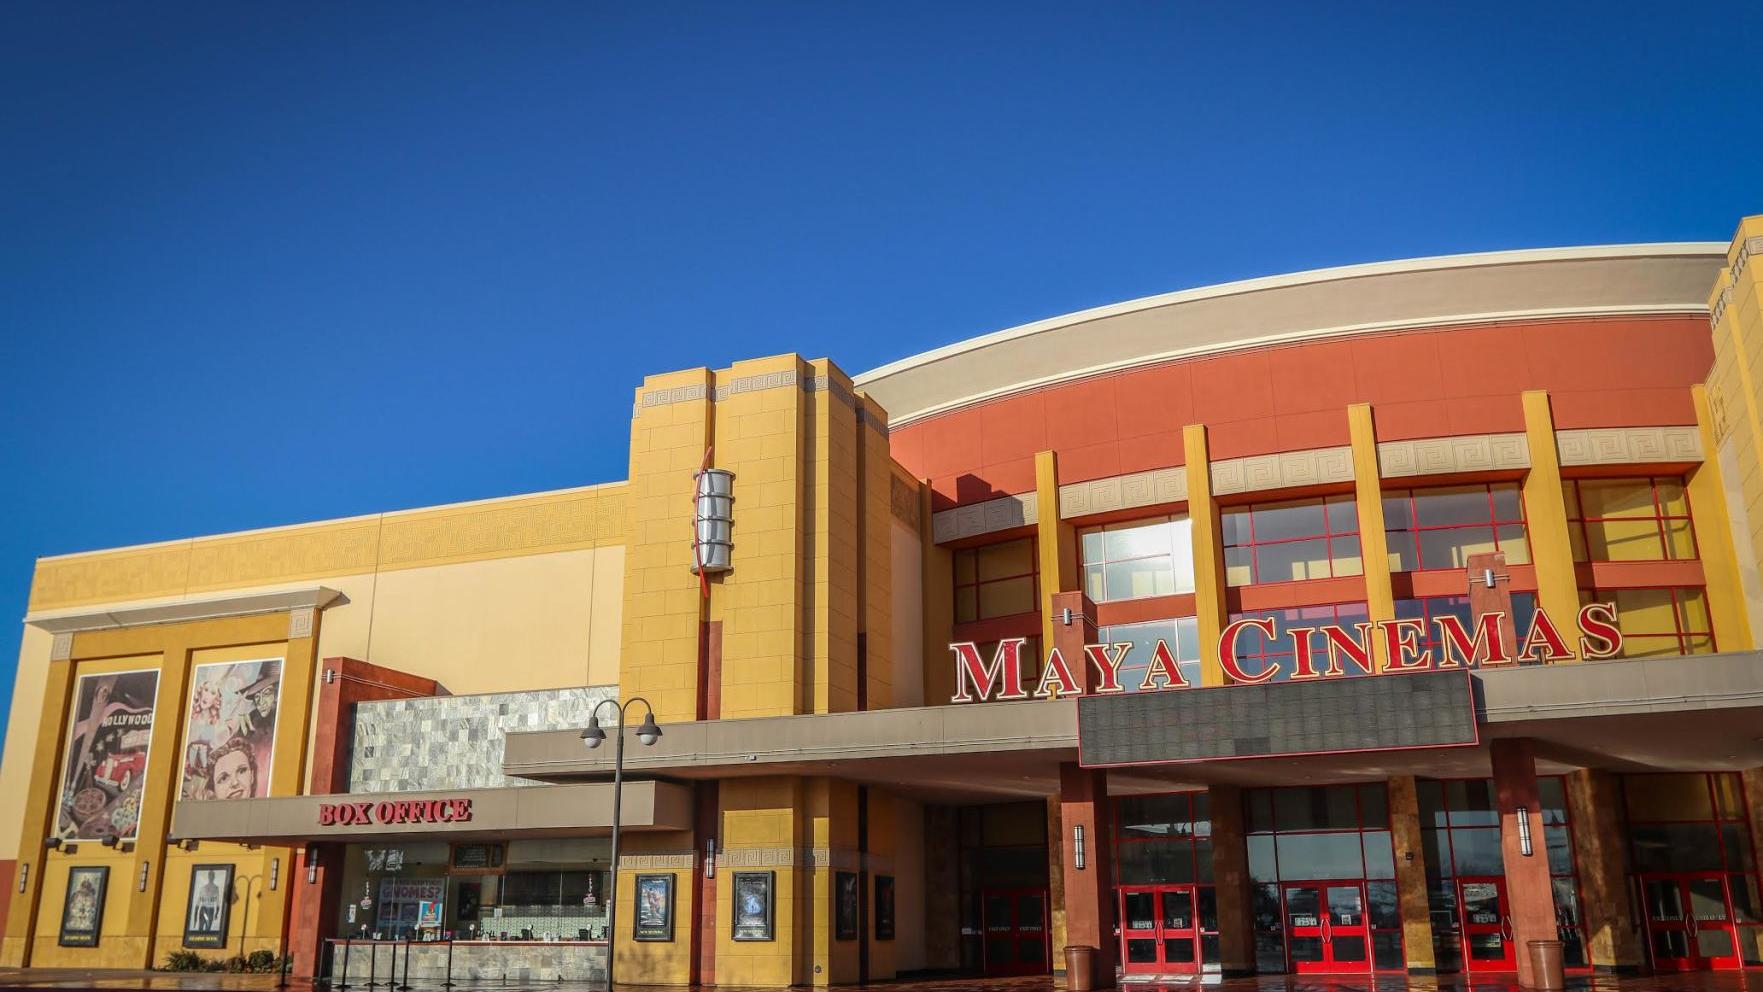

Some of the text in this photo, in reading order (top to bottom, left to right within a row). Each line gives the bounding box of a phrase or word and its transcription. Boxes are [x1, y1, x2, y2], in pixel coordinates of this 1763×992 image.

[948, 601, 1624, 703] MAYA CINEMAS
[102, 713, 153, 728] HOLLYWOOD
[319, 799, 473, 826] BOX OFFICE
